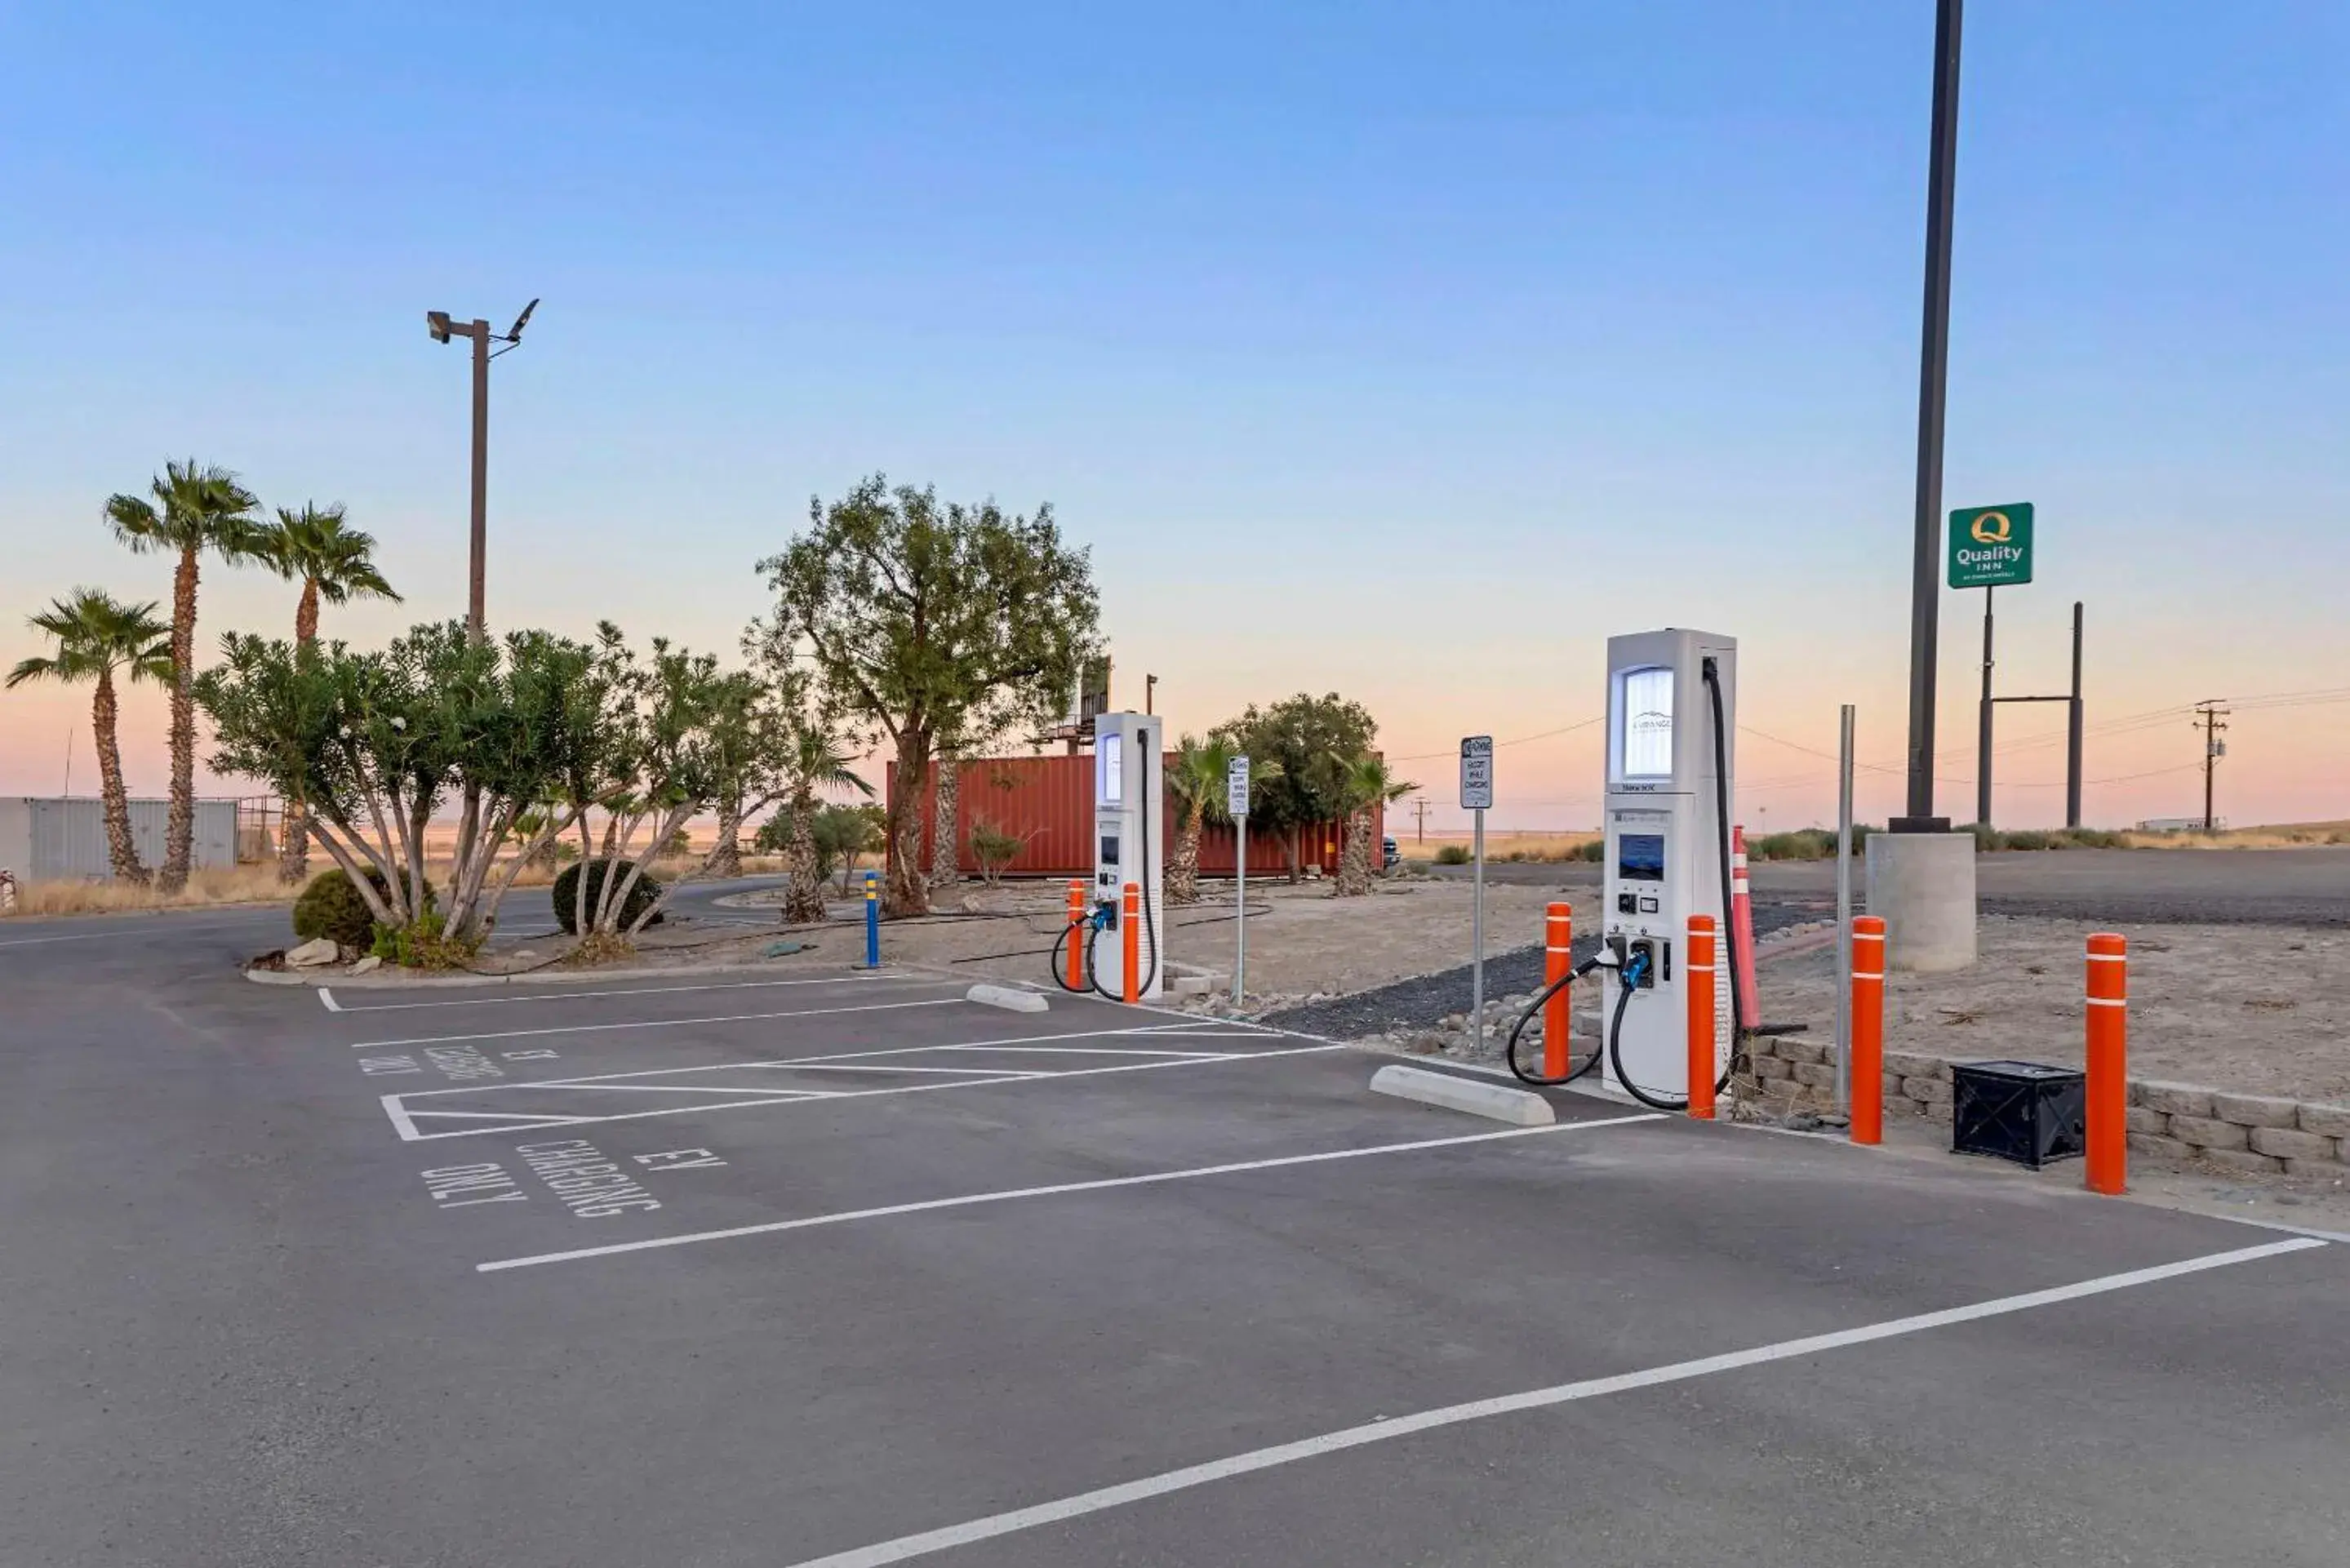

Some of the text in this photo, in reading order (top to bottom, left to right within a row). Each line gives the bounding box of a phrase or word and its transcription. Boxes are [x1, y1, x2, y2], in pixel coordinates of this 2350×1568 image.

[1957, 546, 2023, 565] Quality
[1977, 562, 2002, 571] INN
[634, 1148, 728, 1171] EV
[421, 1162, 529, 1209] ONLY
[516, 1139, 663, 1218] CHARGING
